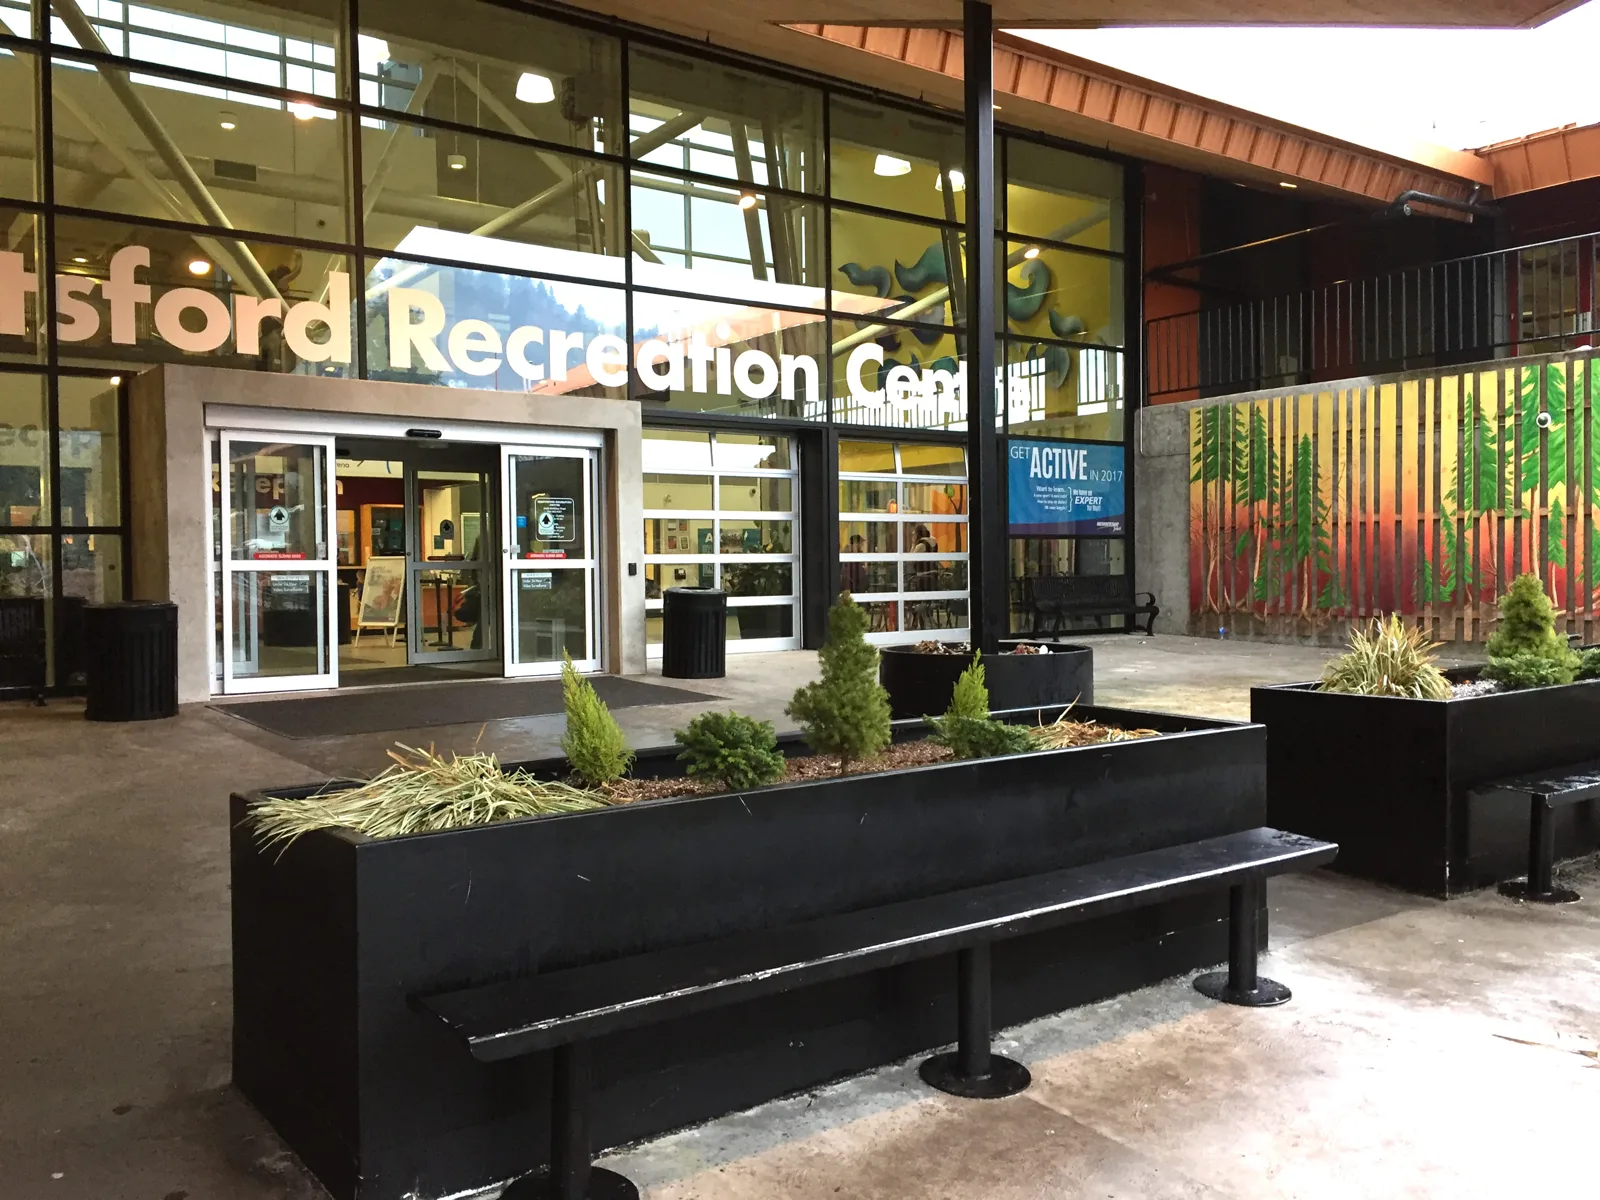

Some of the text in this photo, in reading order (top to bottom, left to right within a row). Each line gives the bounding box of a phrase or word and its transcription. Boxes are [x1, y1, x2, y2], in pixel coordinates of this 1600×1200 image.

[388, 286, 820, 402] Recreation
[1010, 446, 1123, 482] GET ACTIVE IN 2017
[1075, 496, 1103, 505] EXPERT
